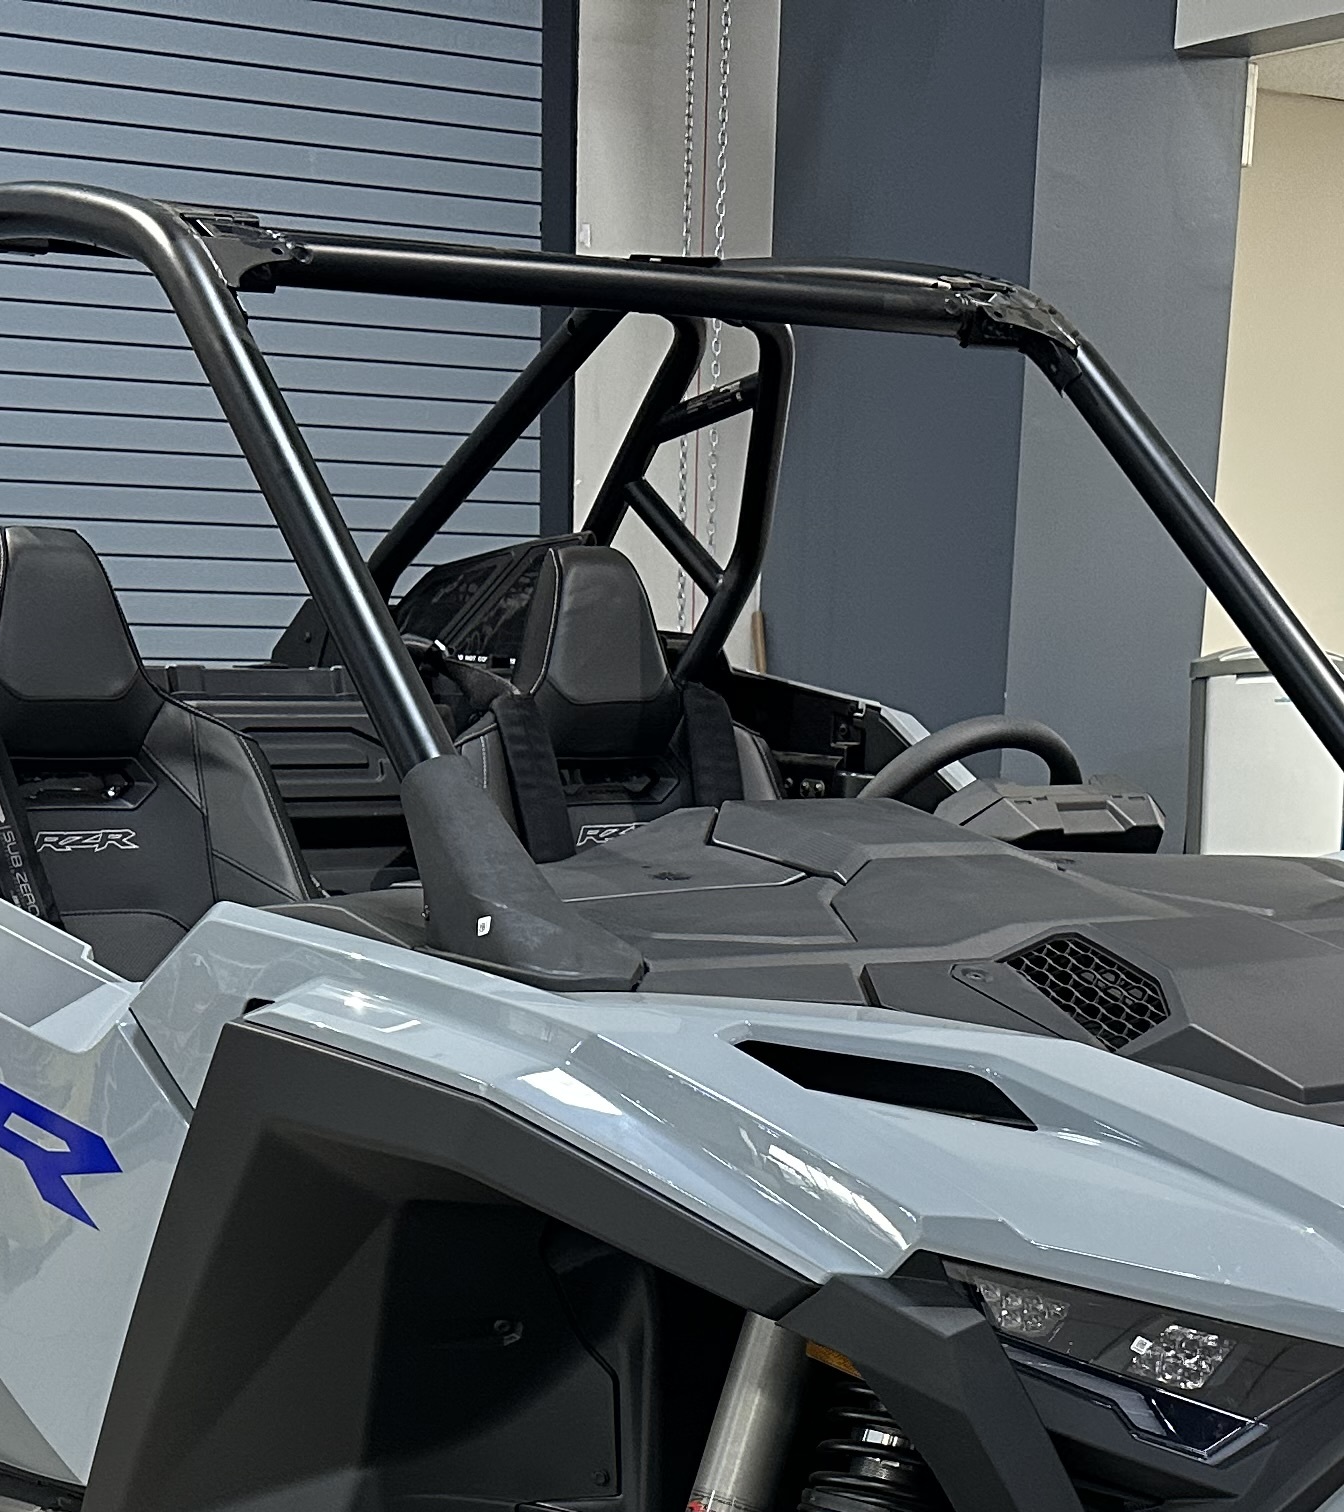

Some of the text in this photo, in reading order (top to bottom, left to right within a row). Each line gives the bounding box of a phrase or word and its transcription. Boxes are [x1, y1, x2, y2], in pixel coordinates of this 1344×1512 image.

[34, 828, 140, 853] RZR
[576, 821, 651, 847] RZ
[2, 830, 23, 868] SUB
